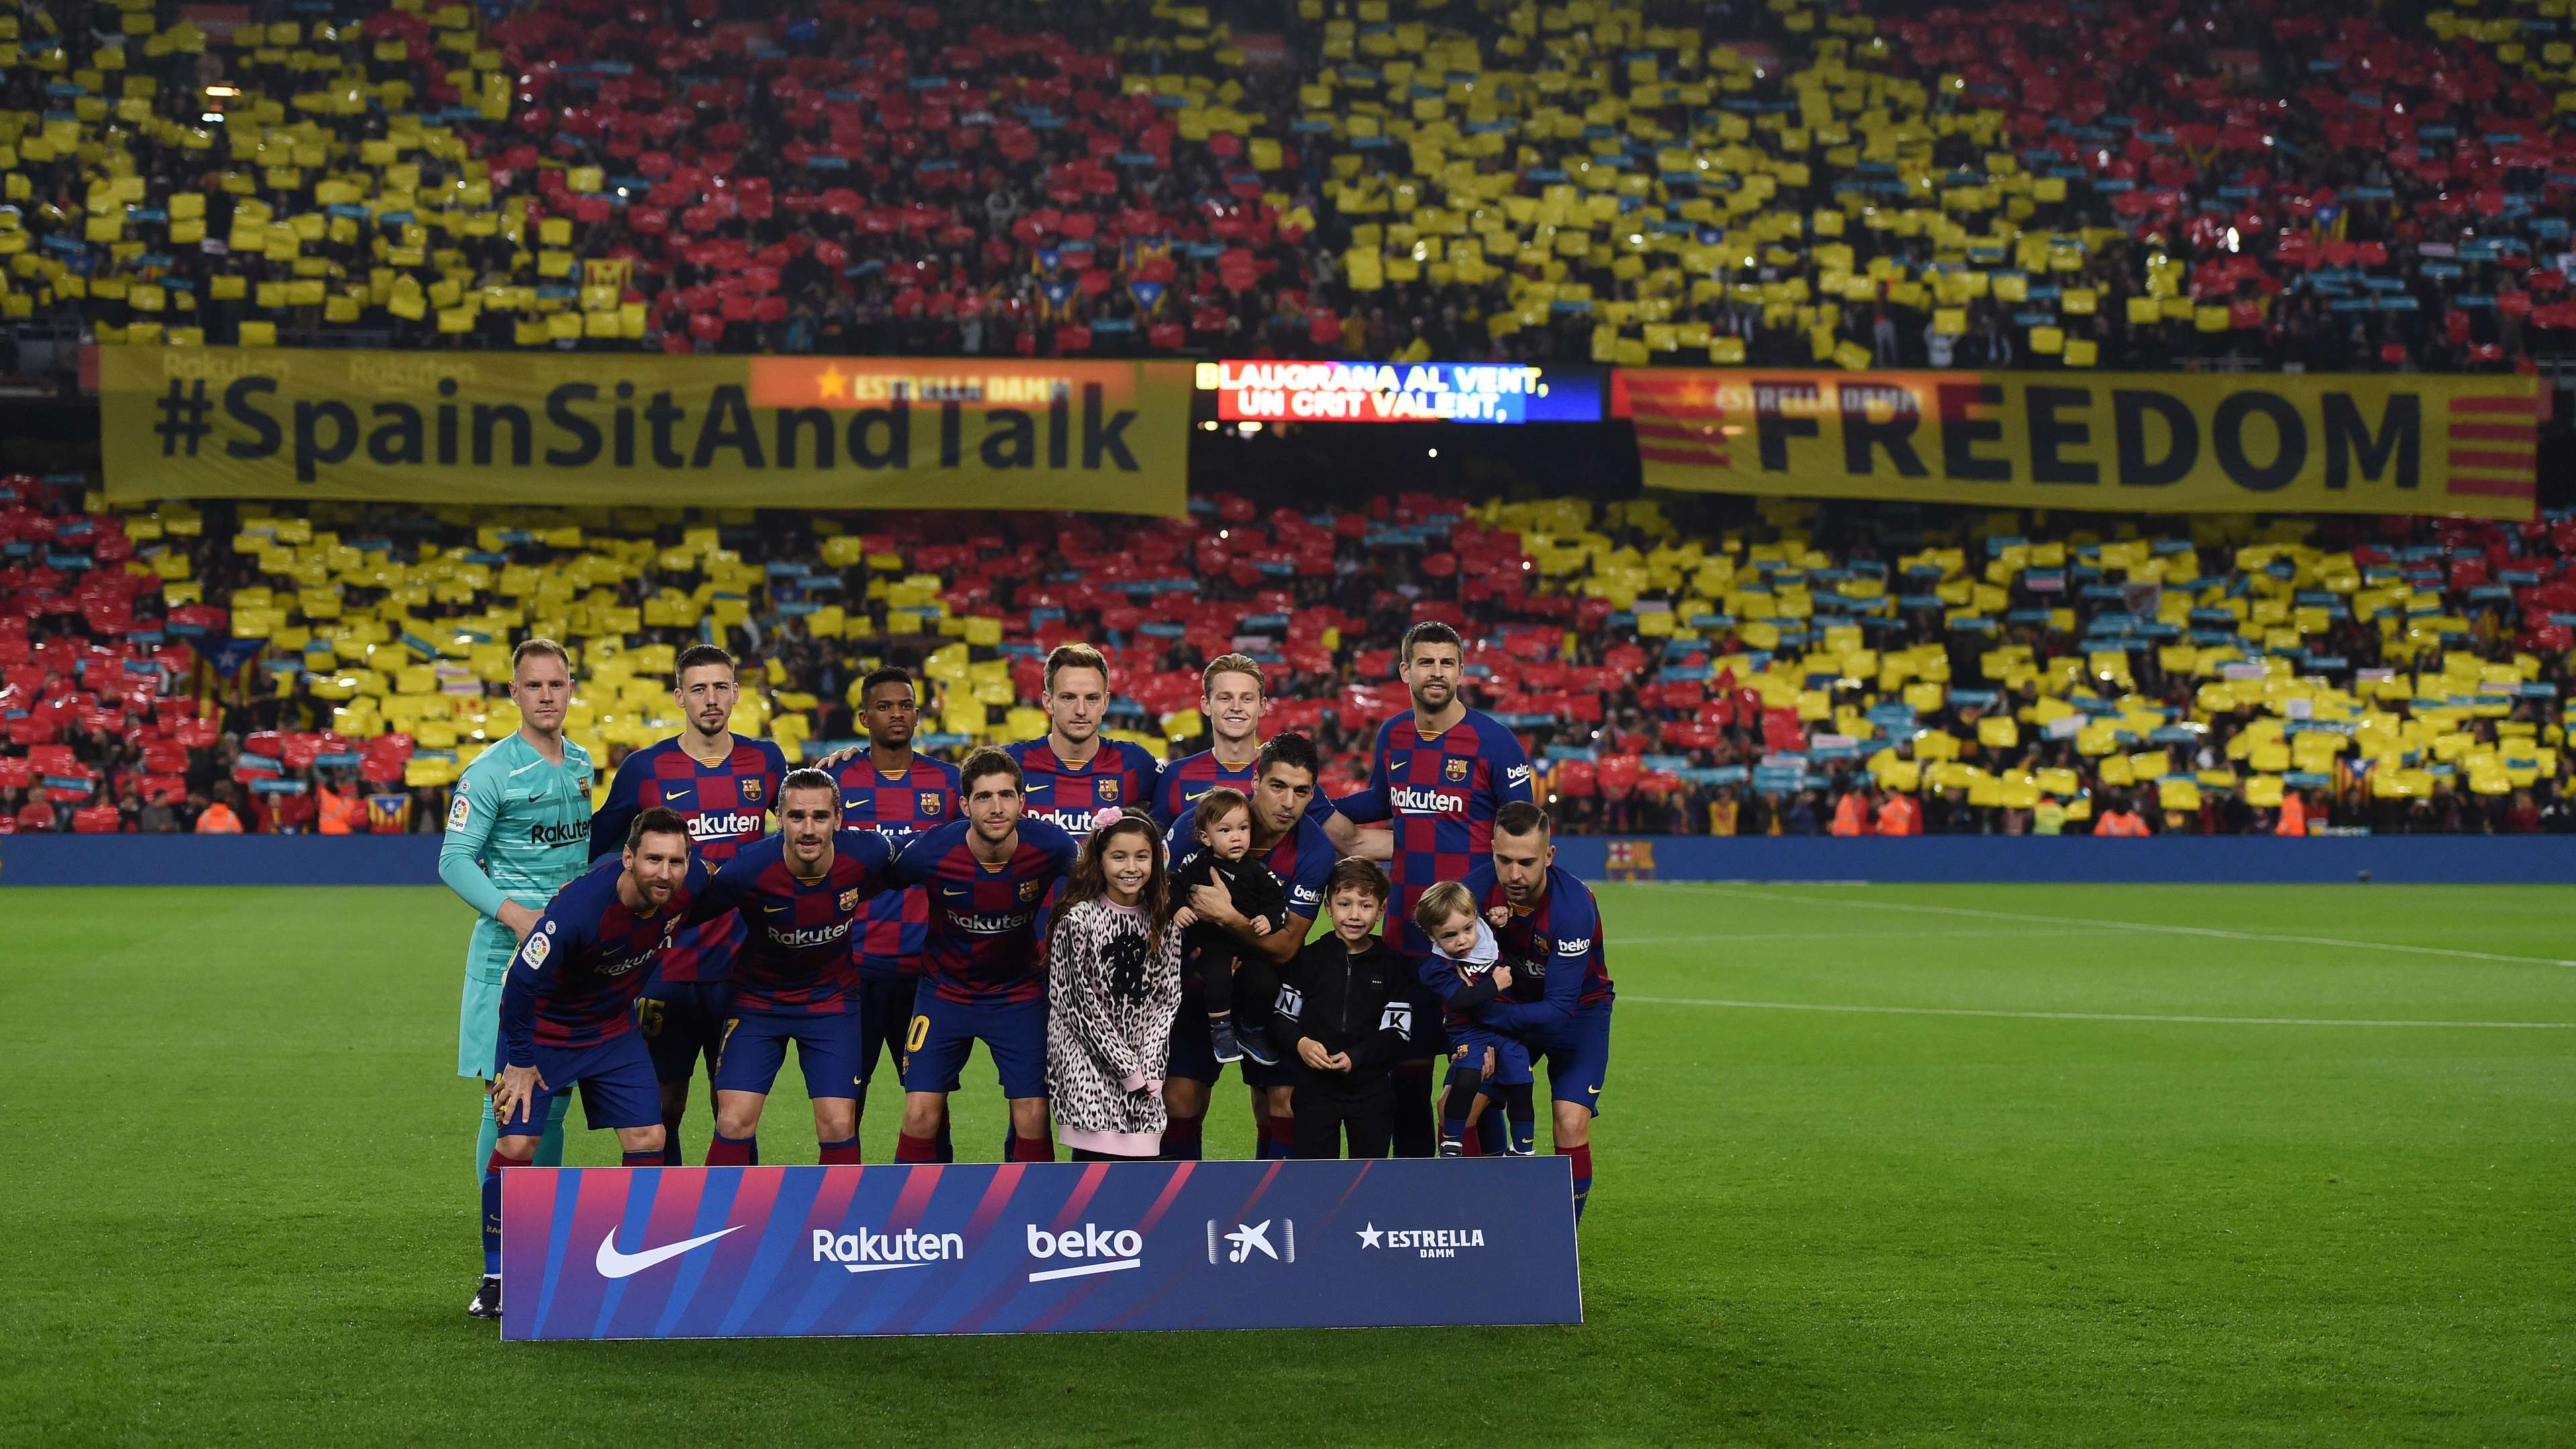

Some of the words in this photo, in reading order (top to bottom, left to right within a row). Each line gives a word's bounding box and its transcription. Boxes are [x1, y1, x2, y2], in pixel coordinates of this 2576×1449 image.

[855, 375, 983, 401] ESTRELLA
[1196, 363, 1399, 392] BLAUGRANA
[1404, 366, 1449, 392] AL
[1454, 367, 1549, 397] VENT,
[1238, 392, 1284, 416] UN
[1291, 392, 1366, 417] CRIT
[1371, 393, 1507, 423] VALENT,
[155, 376, 1142, 483] #SpainSitAndTalk
[1752, 380, 2420, 491] FREEDOM
[1391, 786, 1462, 812] Rakuten
[687, 812, 759, 835] akuten
[1028, 809, 1096, 831] akut
[767, 917, 853, 945] Rakuten
[946, 908, 1034, 930] Rakuten
[524, 949, 539, 965] LaLiga
[593, 934, 674, 975] Rakutn
[1558, 938, 1590, 952] beko
[1389, 1012, 1405, 1029] K
[906, 1015, 930, 1053] 0
[813, 1227, 963, 1263] Rakuten
[1027, 1224, 1142, 1259] beko
[1387, 1230, 1485, 1248] ESTRELLA
[1419, 1249, 1454, 1258] DAMM
